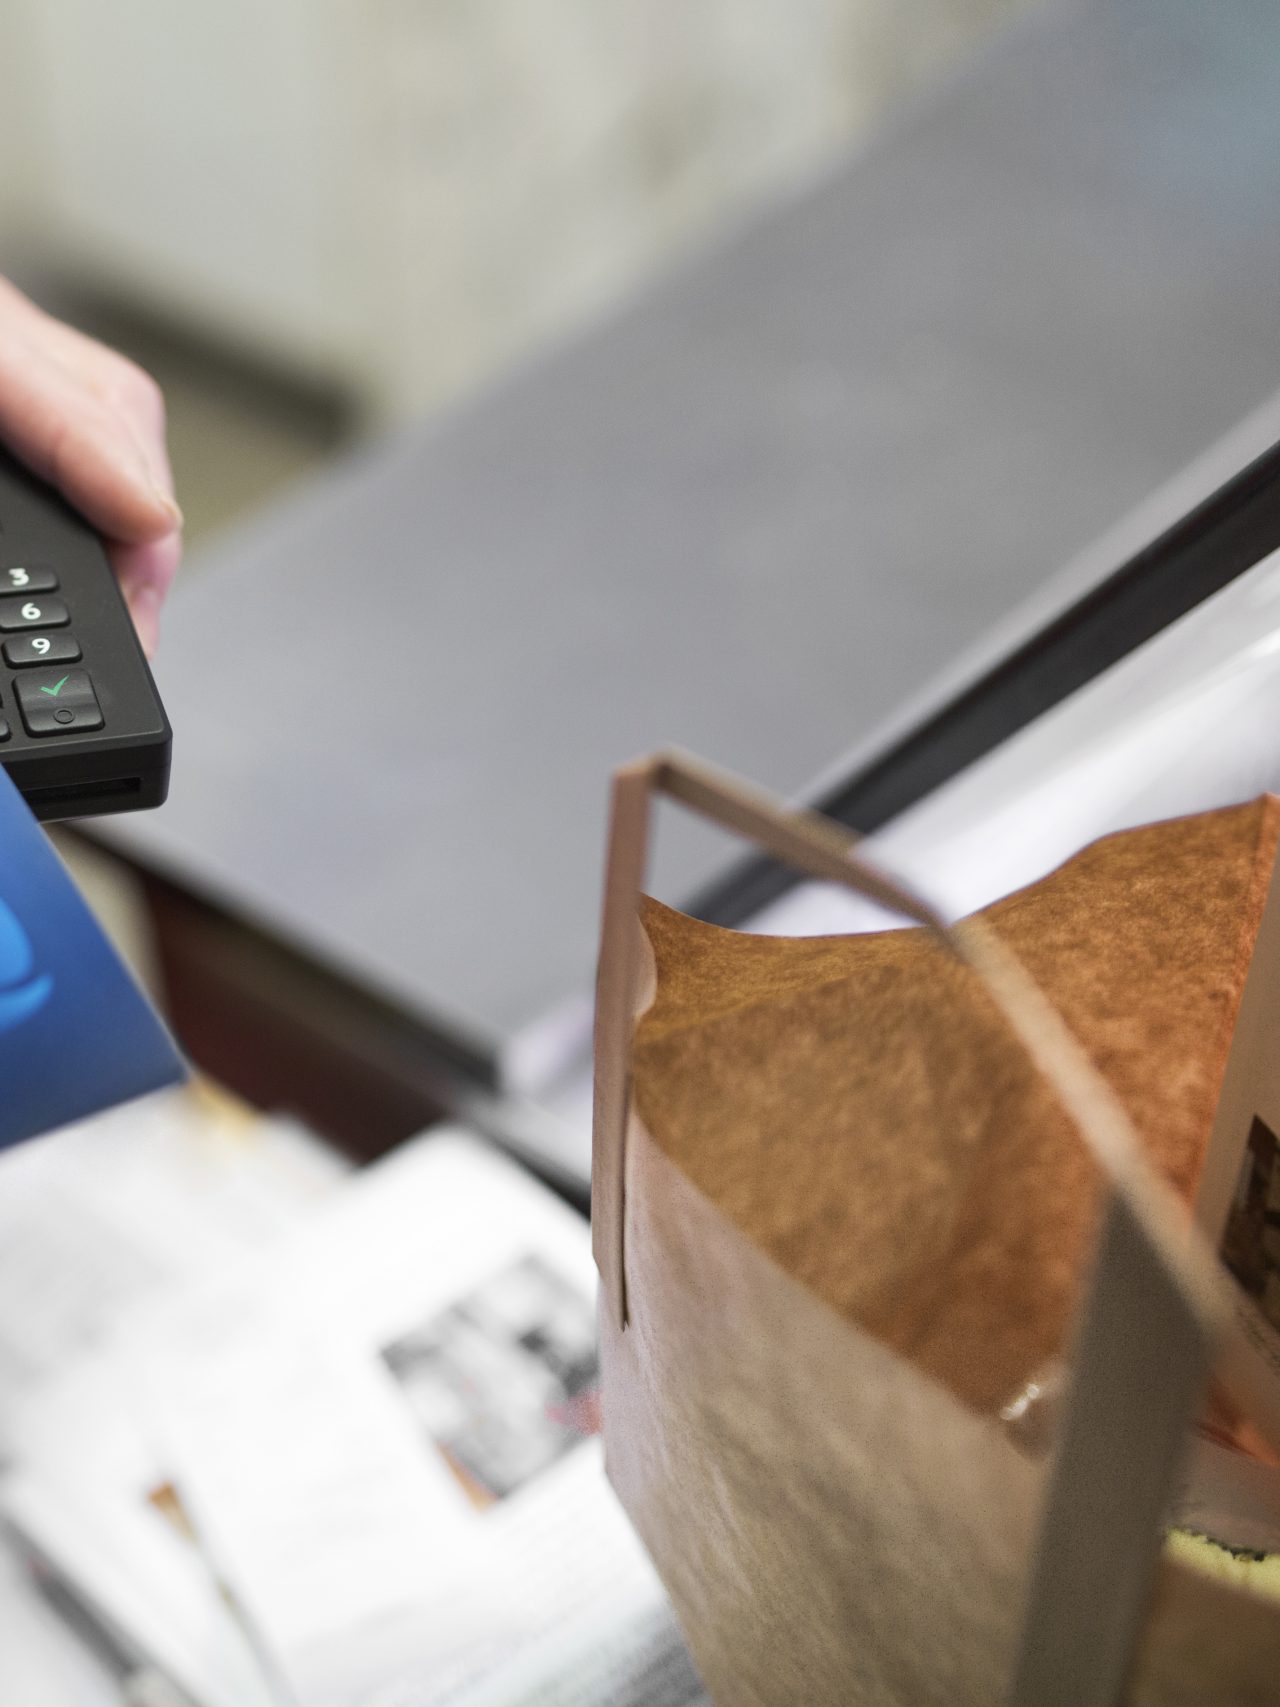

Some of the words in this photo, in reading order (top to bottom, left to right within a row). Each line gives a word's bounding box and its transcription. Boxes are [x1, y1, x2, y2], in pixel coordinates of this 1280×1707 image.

[9, 567, 30, 587] 3
[20, 602, 42, 621] 6
[31, 637, 51, 655] 9
